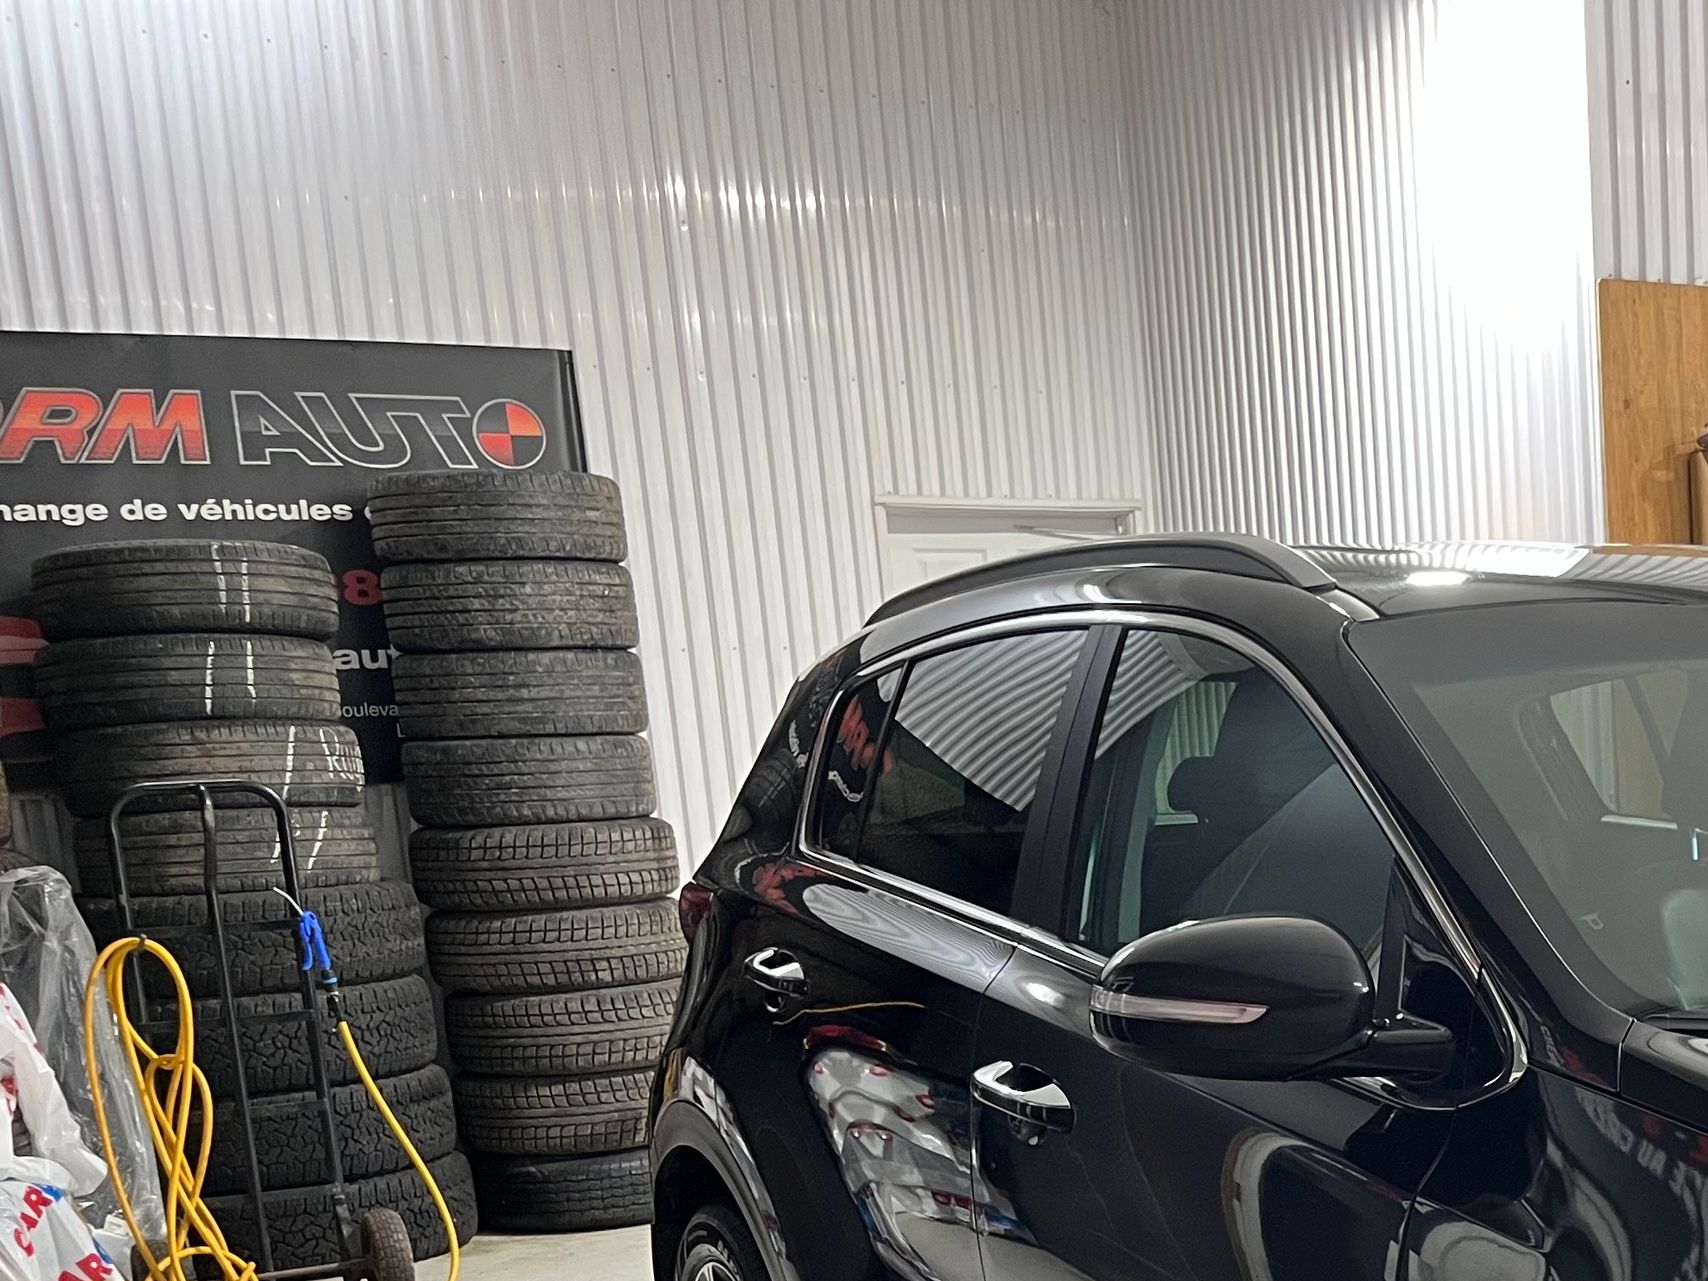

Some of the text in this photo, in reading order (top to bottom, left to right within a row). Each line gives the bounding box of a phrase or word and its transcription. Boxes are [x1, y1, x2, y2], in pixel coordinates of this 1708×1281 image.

[0, 387, 211, 465] RM
[120, 499, 168, 521] de
[177, 498, 353, 521] véhicules
[342, 701, 399, 718] ouleva
